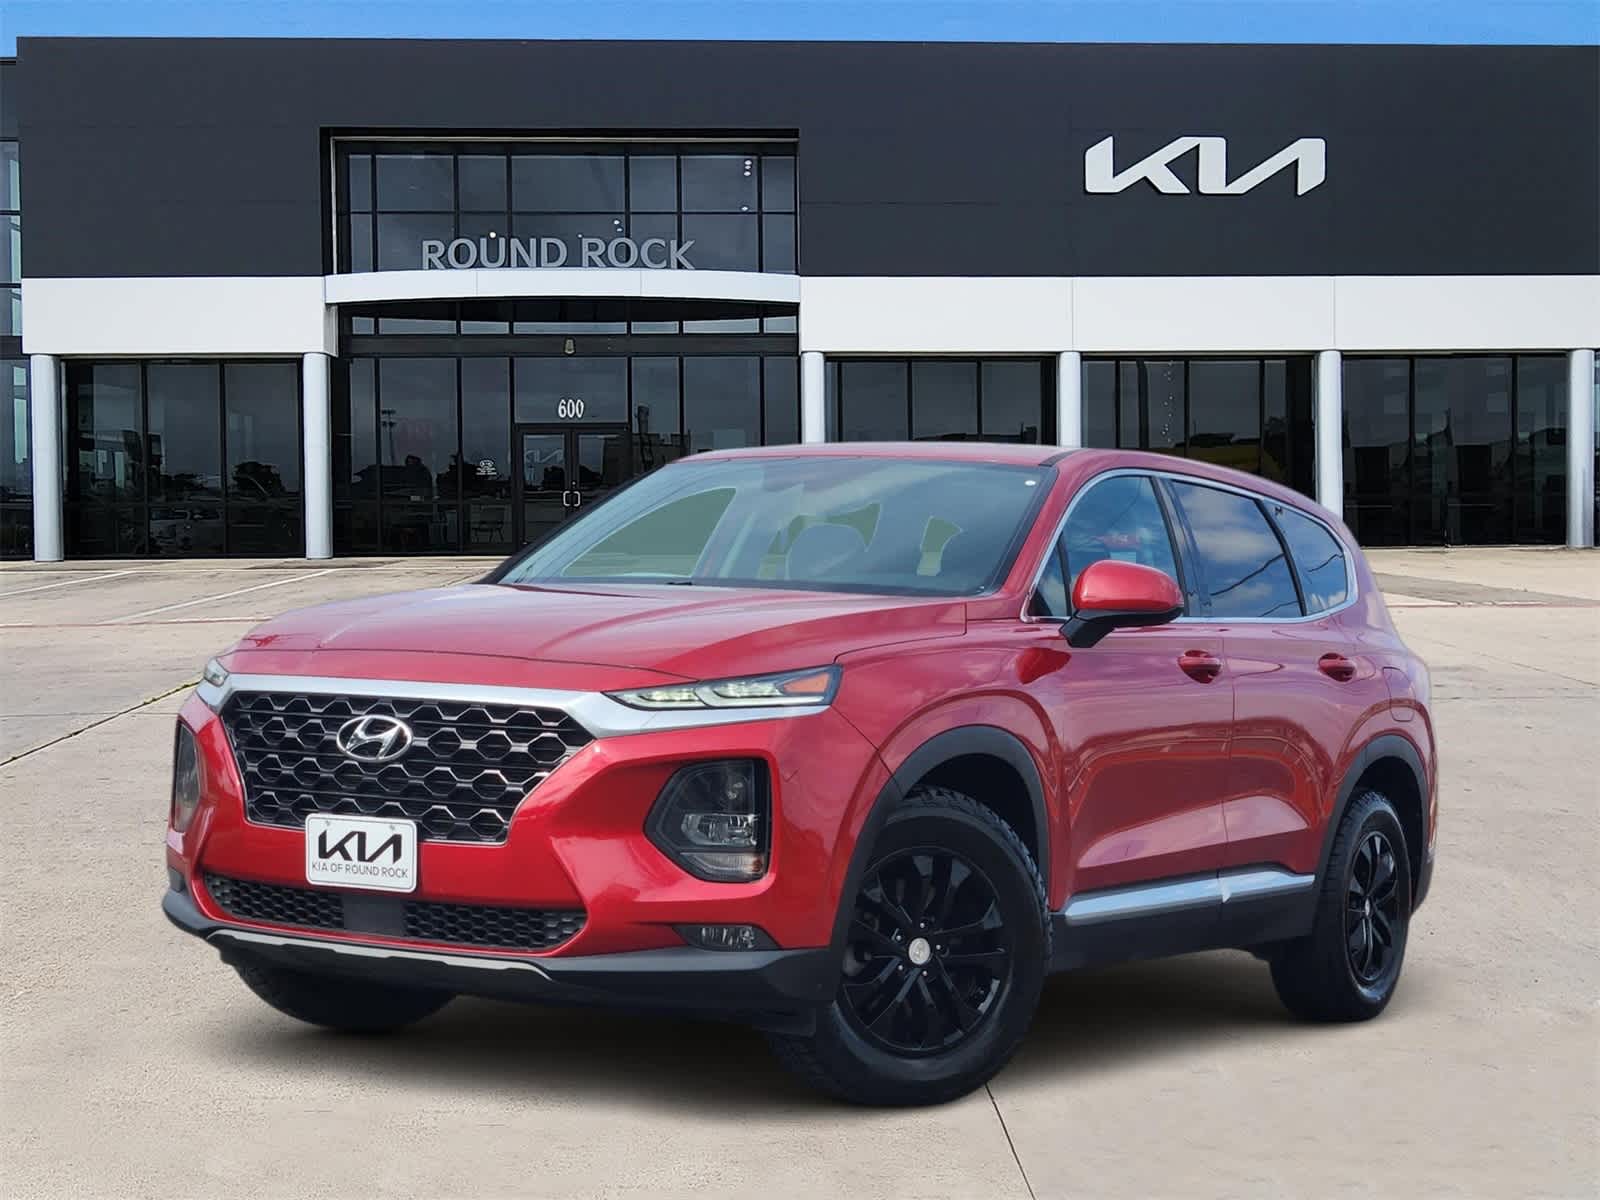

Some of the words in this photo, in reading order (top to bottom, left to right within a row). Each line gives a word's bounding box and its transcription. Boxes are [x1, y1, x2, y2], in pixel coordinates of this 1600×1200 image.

[1085, 135, 1326, 196] KIA
[422, 237, 567, 270] ROUND
[581, 237, 695, 270] ROCK
[558, 399, 584, 418] 600
[318, 829, 402, 865] KIA
[312, 862, 328, 871] KIA
[330, 863, 343, 873] OF
[345, 864, 380, 876] ROUND
[381, 867, 409, 879] ROCK
